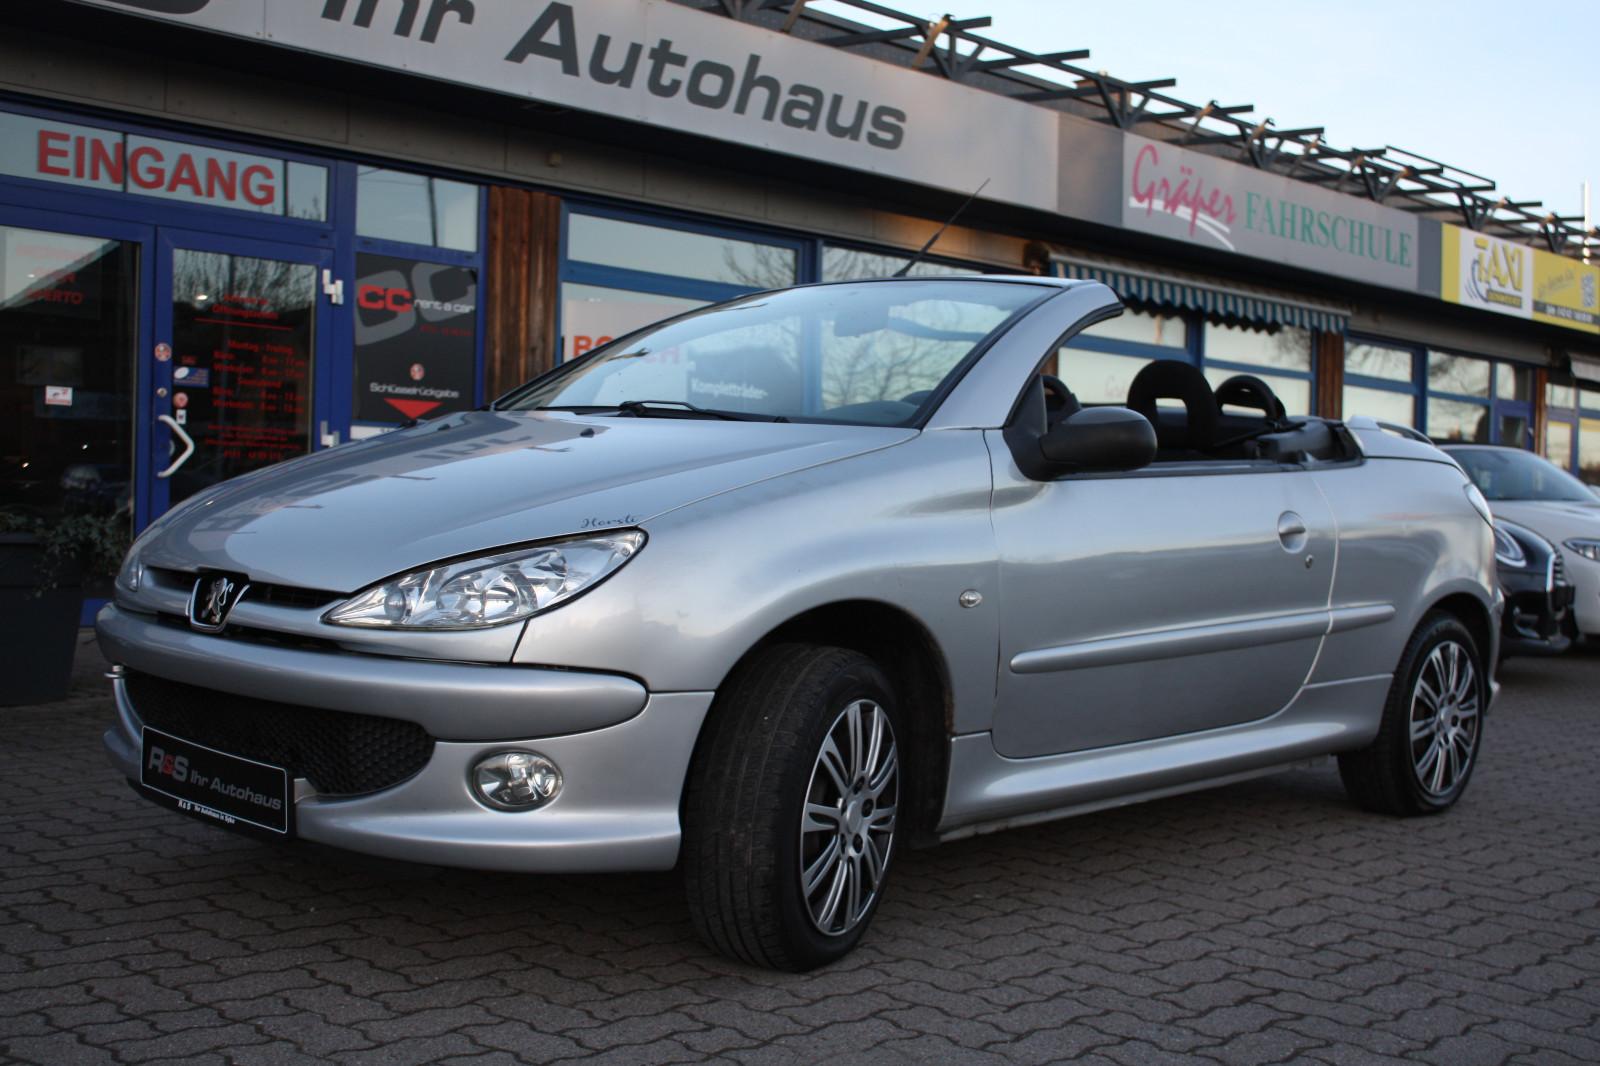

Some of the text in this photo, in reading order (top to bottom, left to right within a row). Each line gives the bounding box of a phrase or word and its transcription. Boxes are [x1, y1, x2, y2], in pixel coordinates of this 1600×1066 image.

[503, 1, 908, 150] Autohaus
[37, 129, 276, 206] EINGANG
[1132, 144, 1411, 267] Gräper FAHRSCHULE
[358, 284, 412, 313] CC
[369, 382, 459, 399] Schlüsselrückgabe
[190, 769, 208, 786] Ihr
[210, 777, 282, 810] Autohaus
